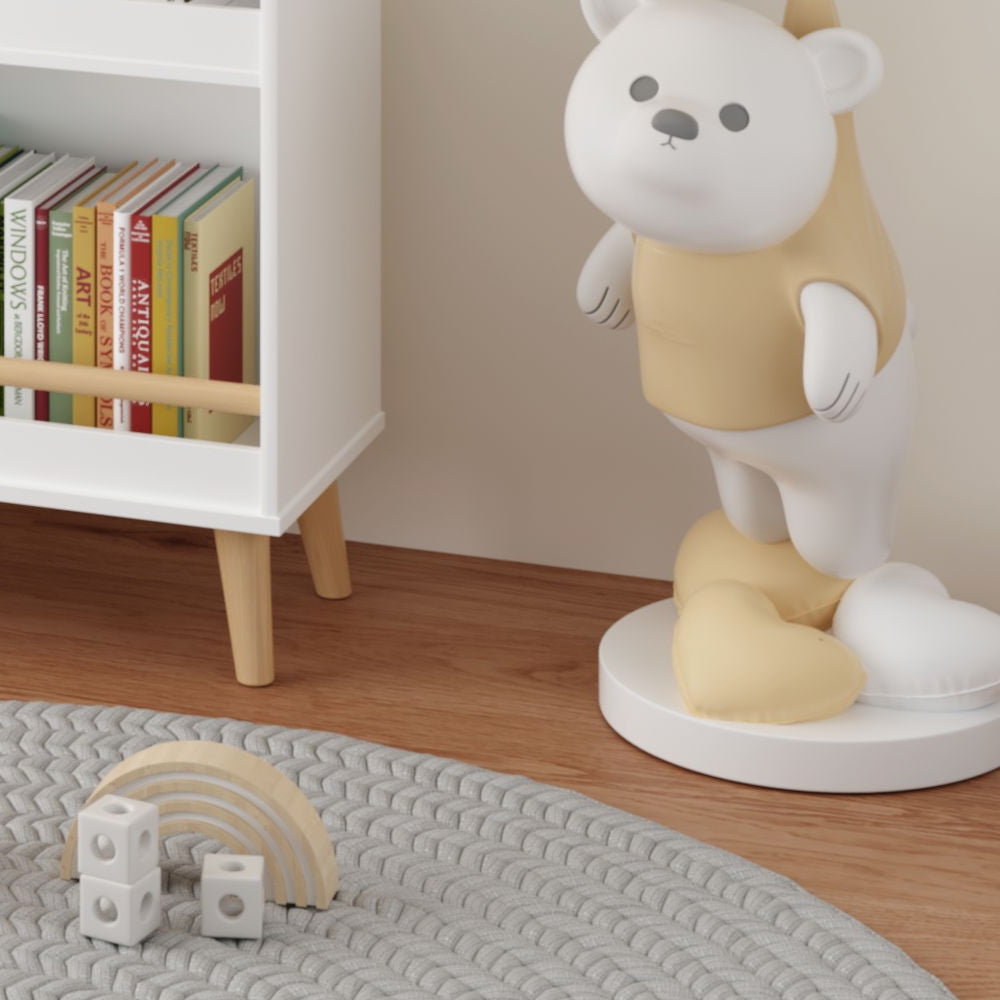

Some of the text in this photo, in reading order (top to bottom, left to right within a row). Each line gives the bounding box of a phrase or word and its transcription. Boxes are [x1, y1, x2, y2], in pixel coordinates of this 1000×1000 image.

[10, 208, 27, 310] WINDOWS
[61, 249, 69, 263] The
[118, 227, 126, 266] FORMULA
[190, 233, 198, 272] TEXTILES
[61, 263, 69, 275] Art
[75, 267, 92, 306] ART
[211, 255, 242, 297] TEXTILES
[36, 284, 45, 312] FRANK
[99, 264, 113, 316] BOOK
[118, 275, 126, 304] WORLD
[36, 313, 45, 340] LLOYD
[101, 319, 107, 331] OF
[118, 306, 126, 354] CHAMPIONS
